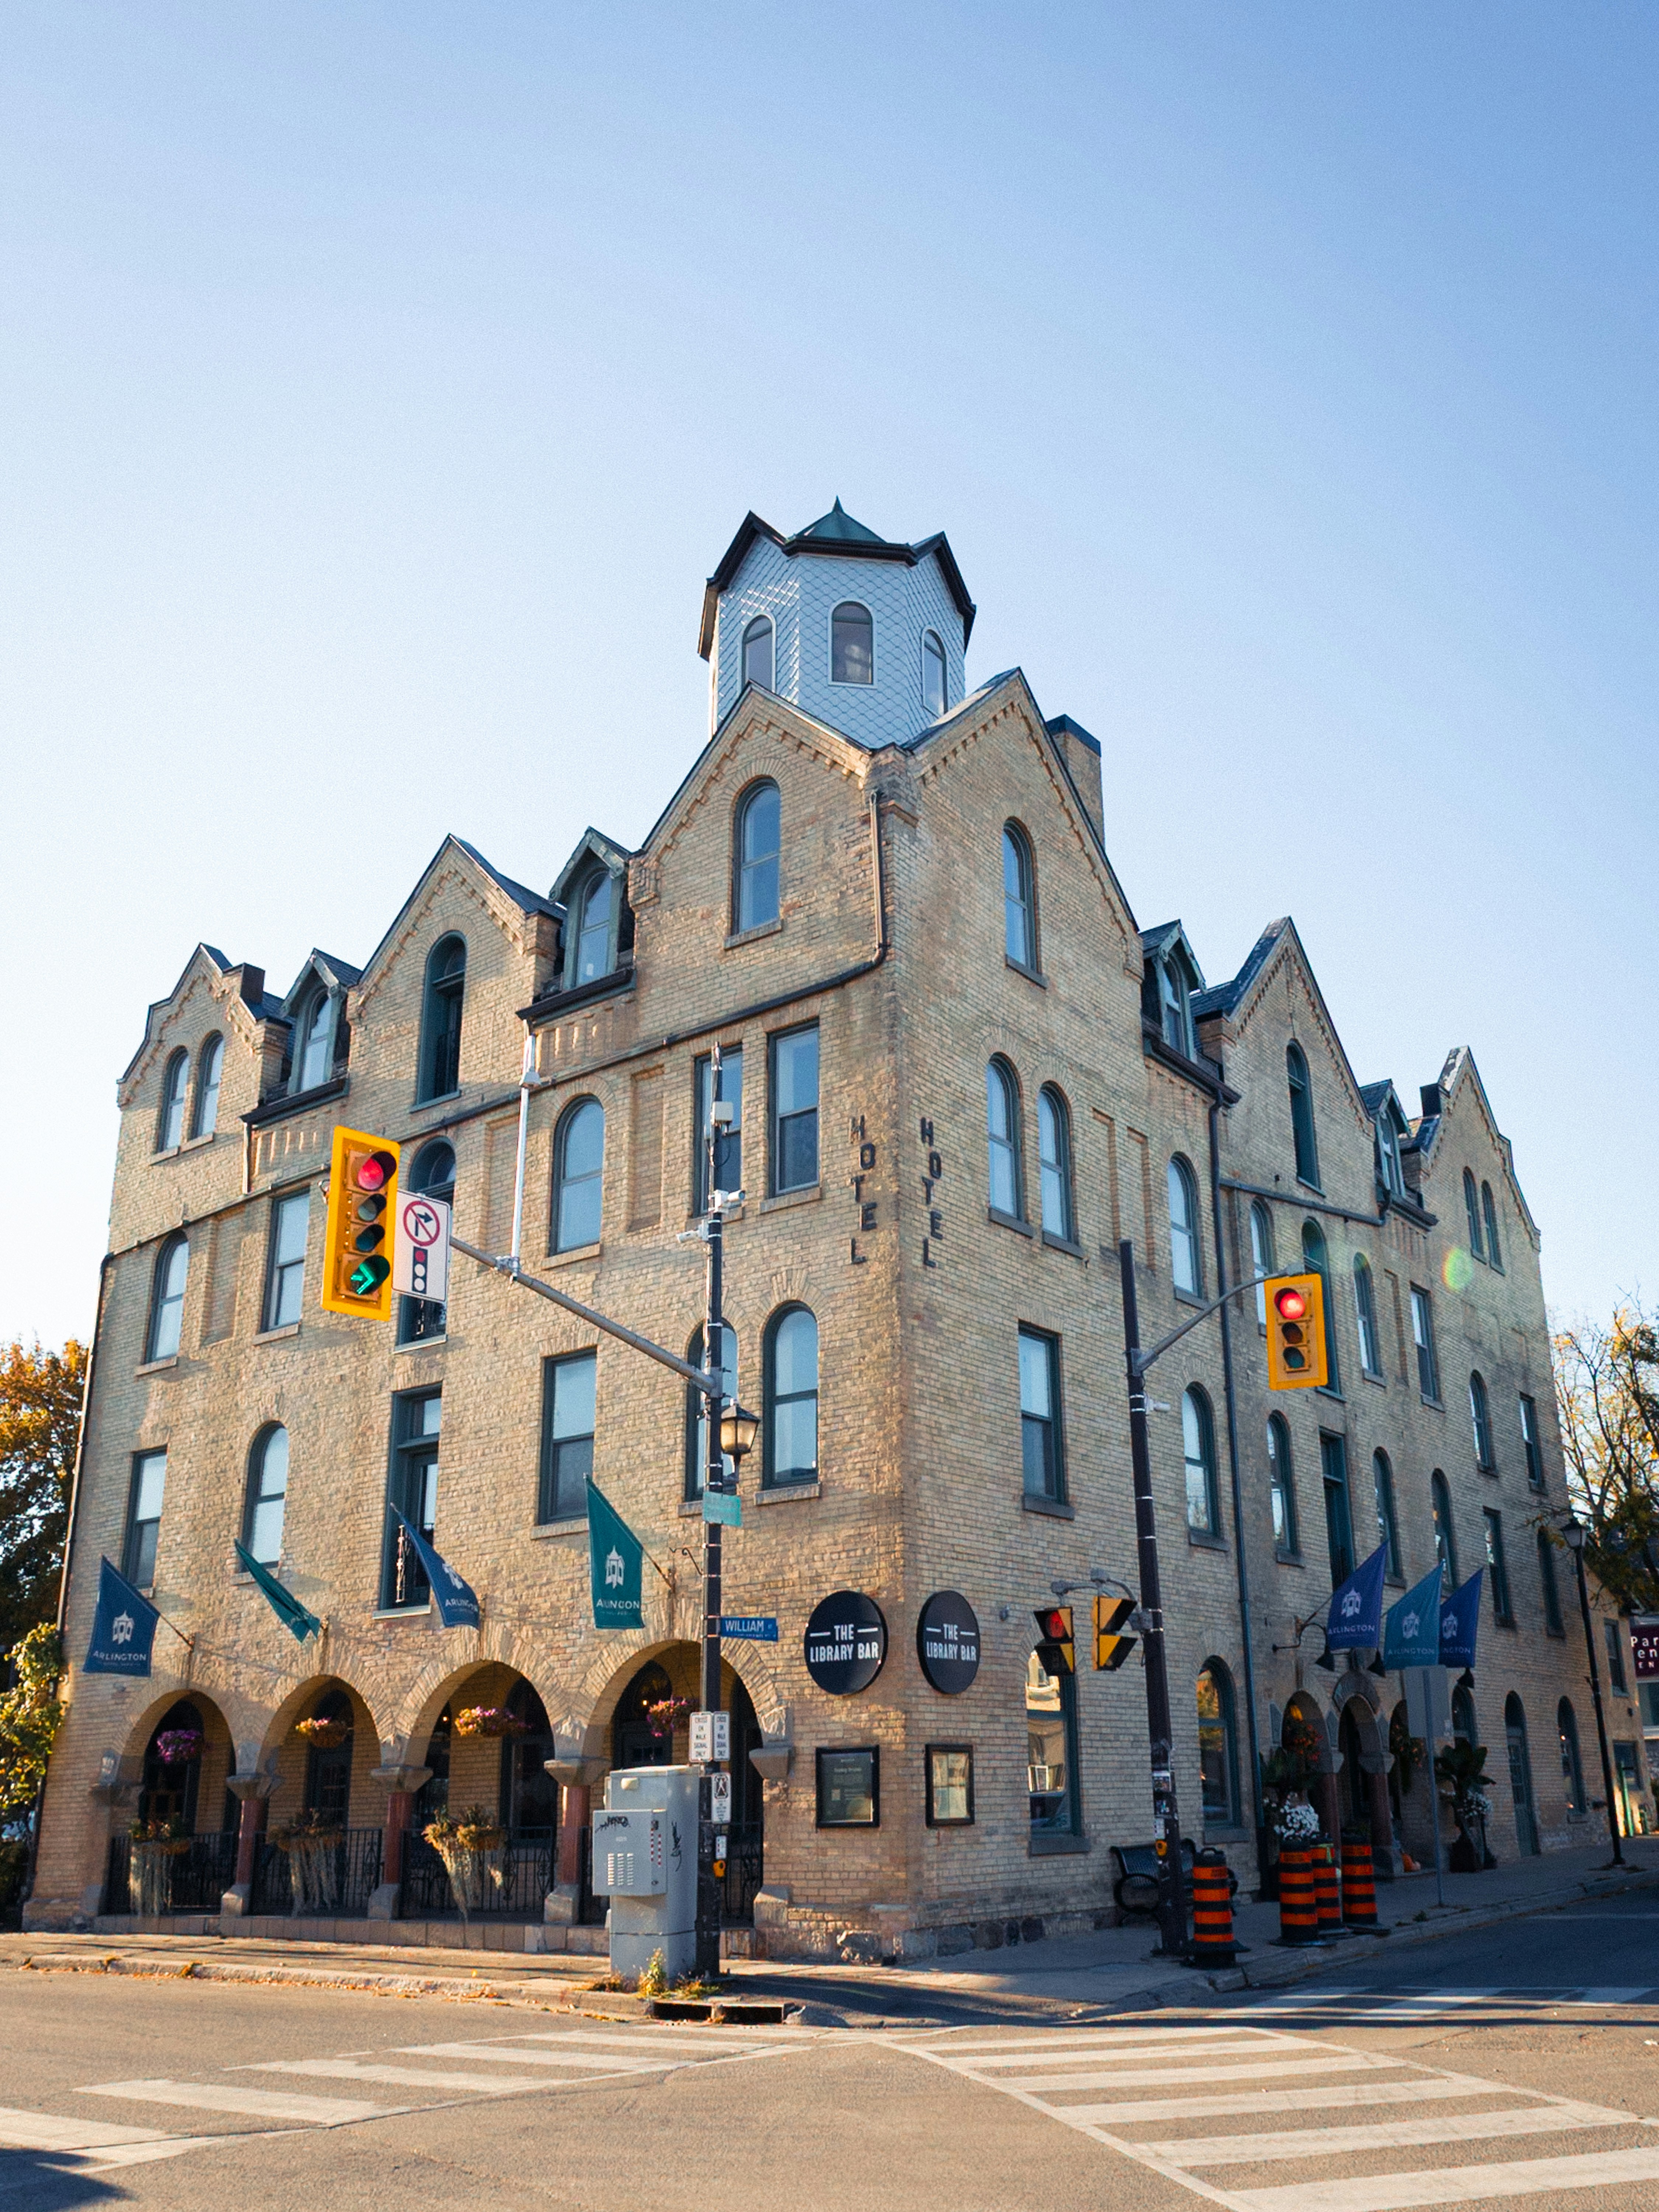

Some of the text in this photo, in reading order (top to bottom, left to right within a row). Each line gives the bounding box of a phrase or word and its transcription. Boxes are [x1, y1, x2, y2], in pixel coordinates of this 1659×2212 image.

[850, 1115, 878, 1265] HOTEL
[921, 1117, 943, 1268] HOTEL
[725, 1620, 764, 1632] WILLIAM
[834, 1624, 854, 1641] THE
[943, 1623, 958, 1640] THE
[93, 1650, 146, 1661] ARLINGTON
[810, 1641, 879, 1662] LIBRARY BAR
[926, 1641, 976, 1661] LIBRARY BAR
